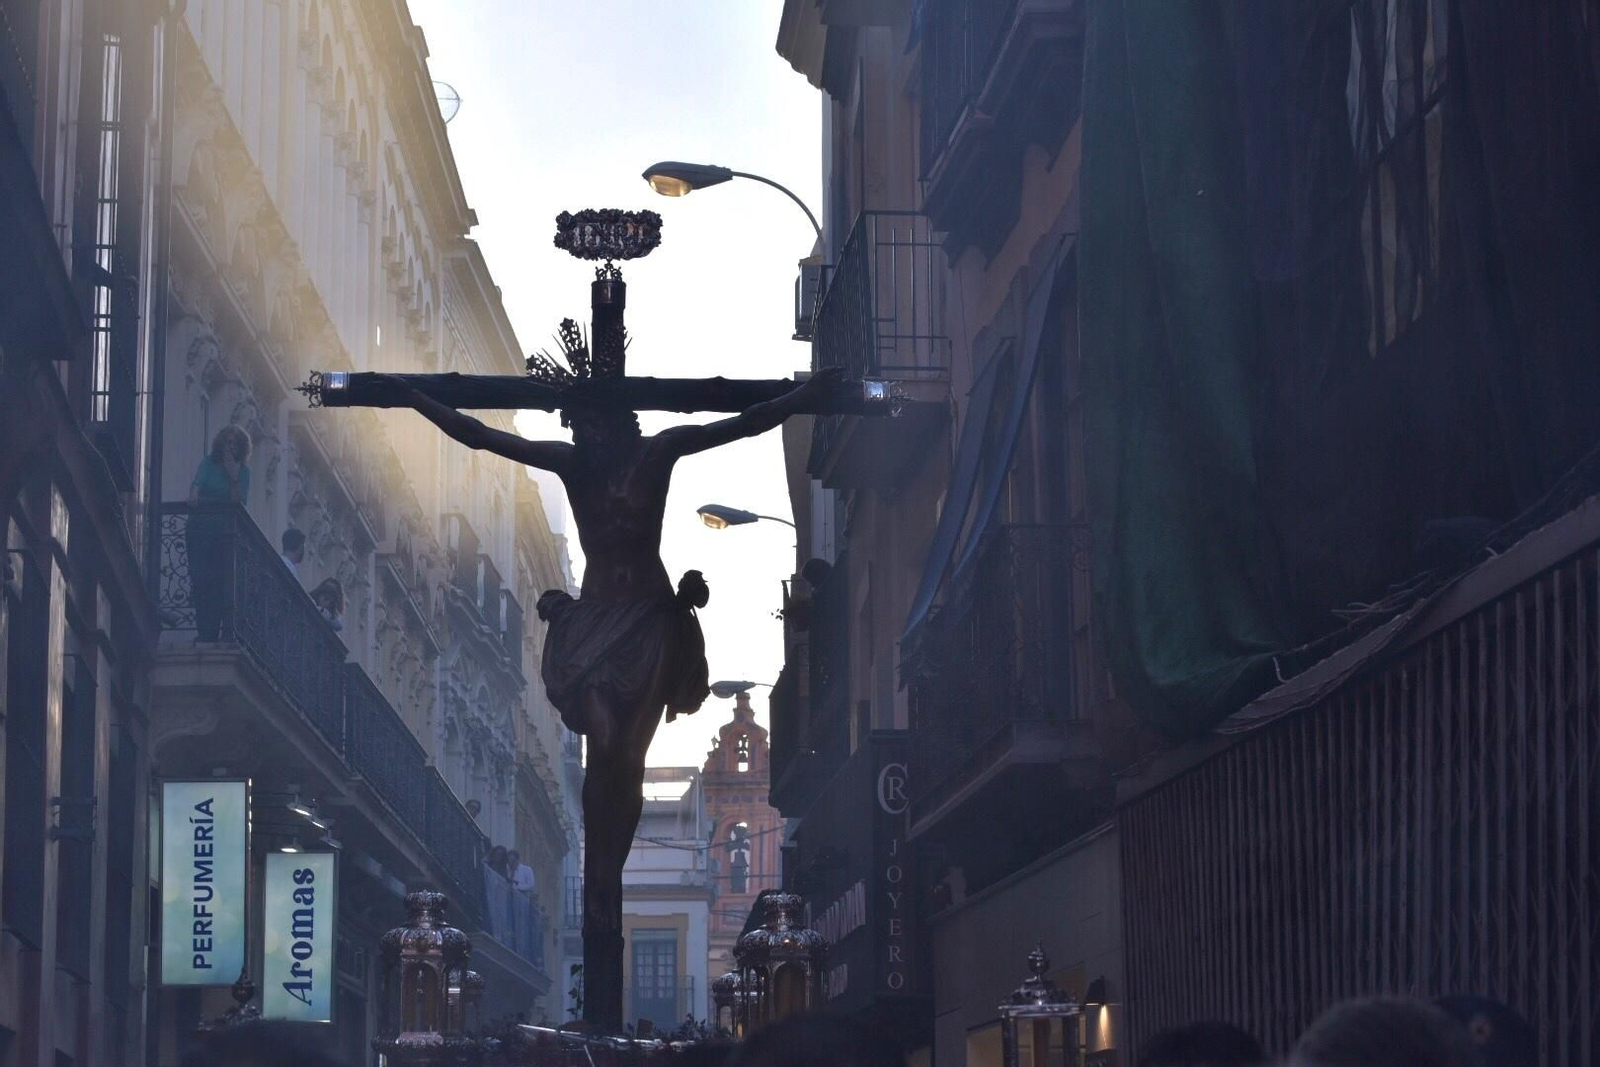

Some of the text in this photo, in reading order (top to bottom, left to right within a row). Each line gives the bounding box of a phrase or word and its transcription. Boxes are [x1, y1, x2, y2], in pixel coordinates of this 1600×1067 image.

[189, 798, 214, 969] PERFUMERÍA
[282, 868, 315, 1006] Aromas
[886, 839, 904, 989] JOYERO
